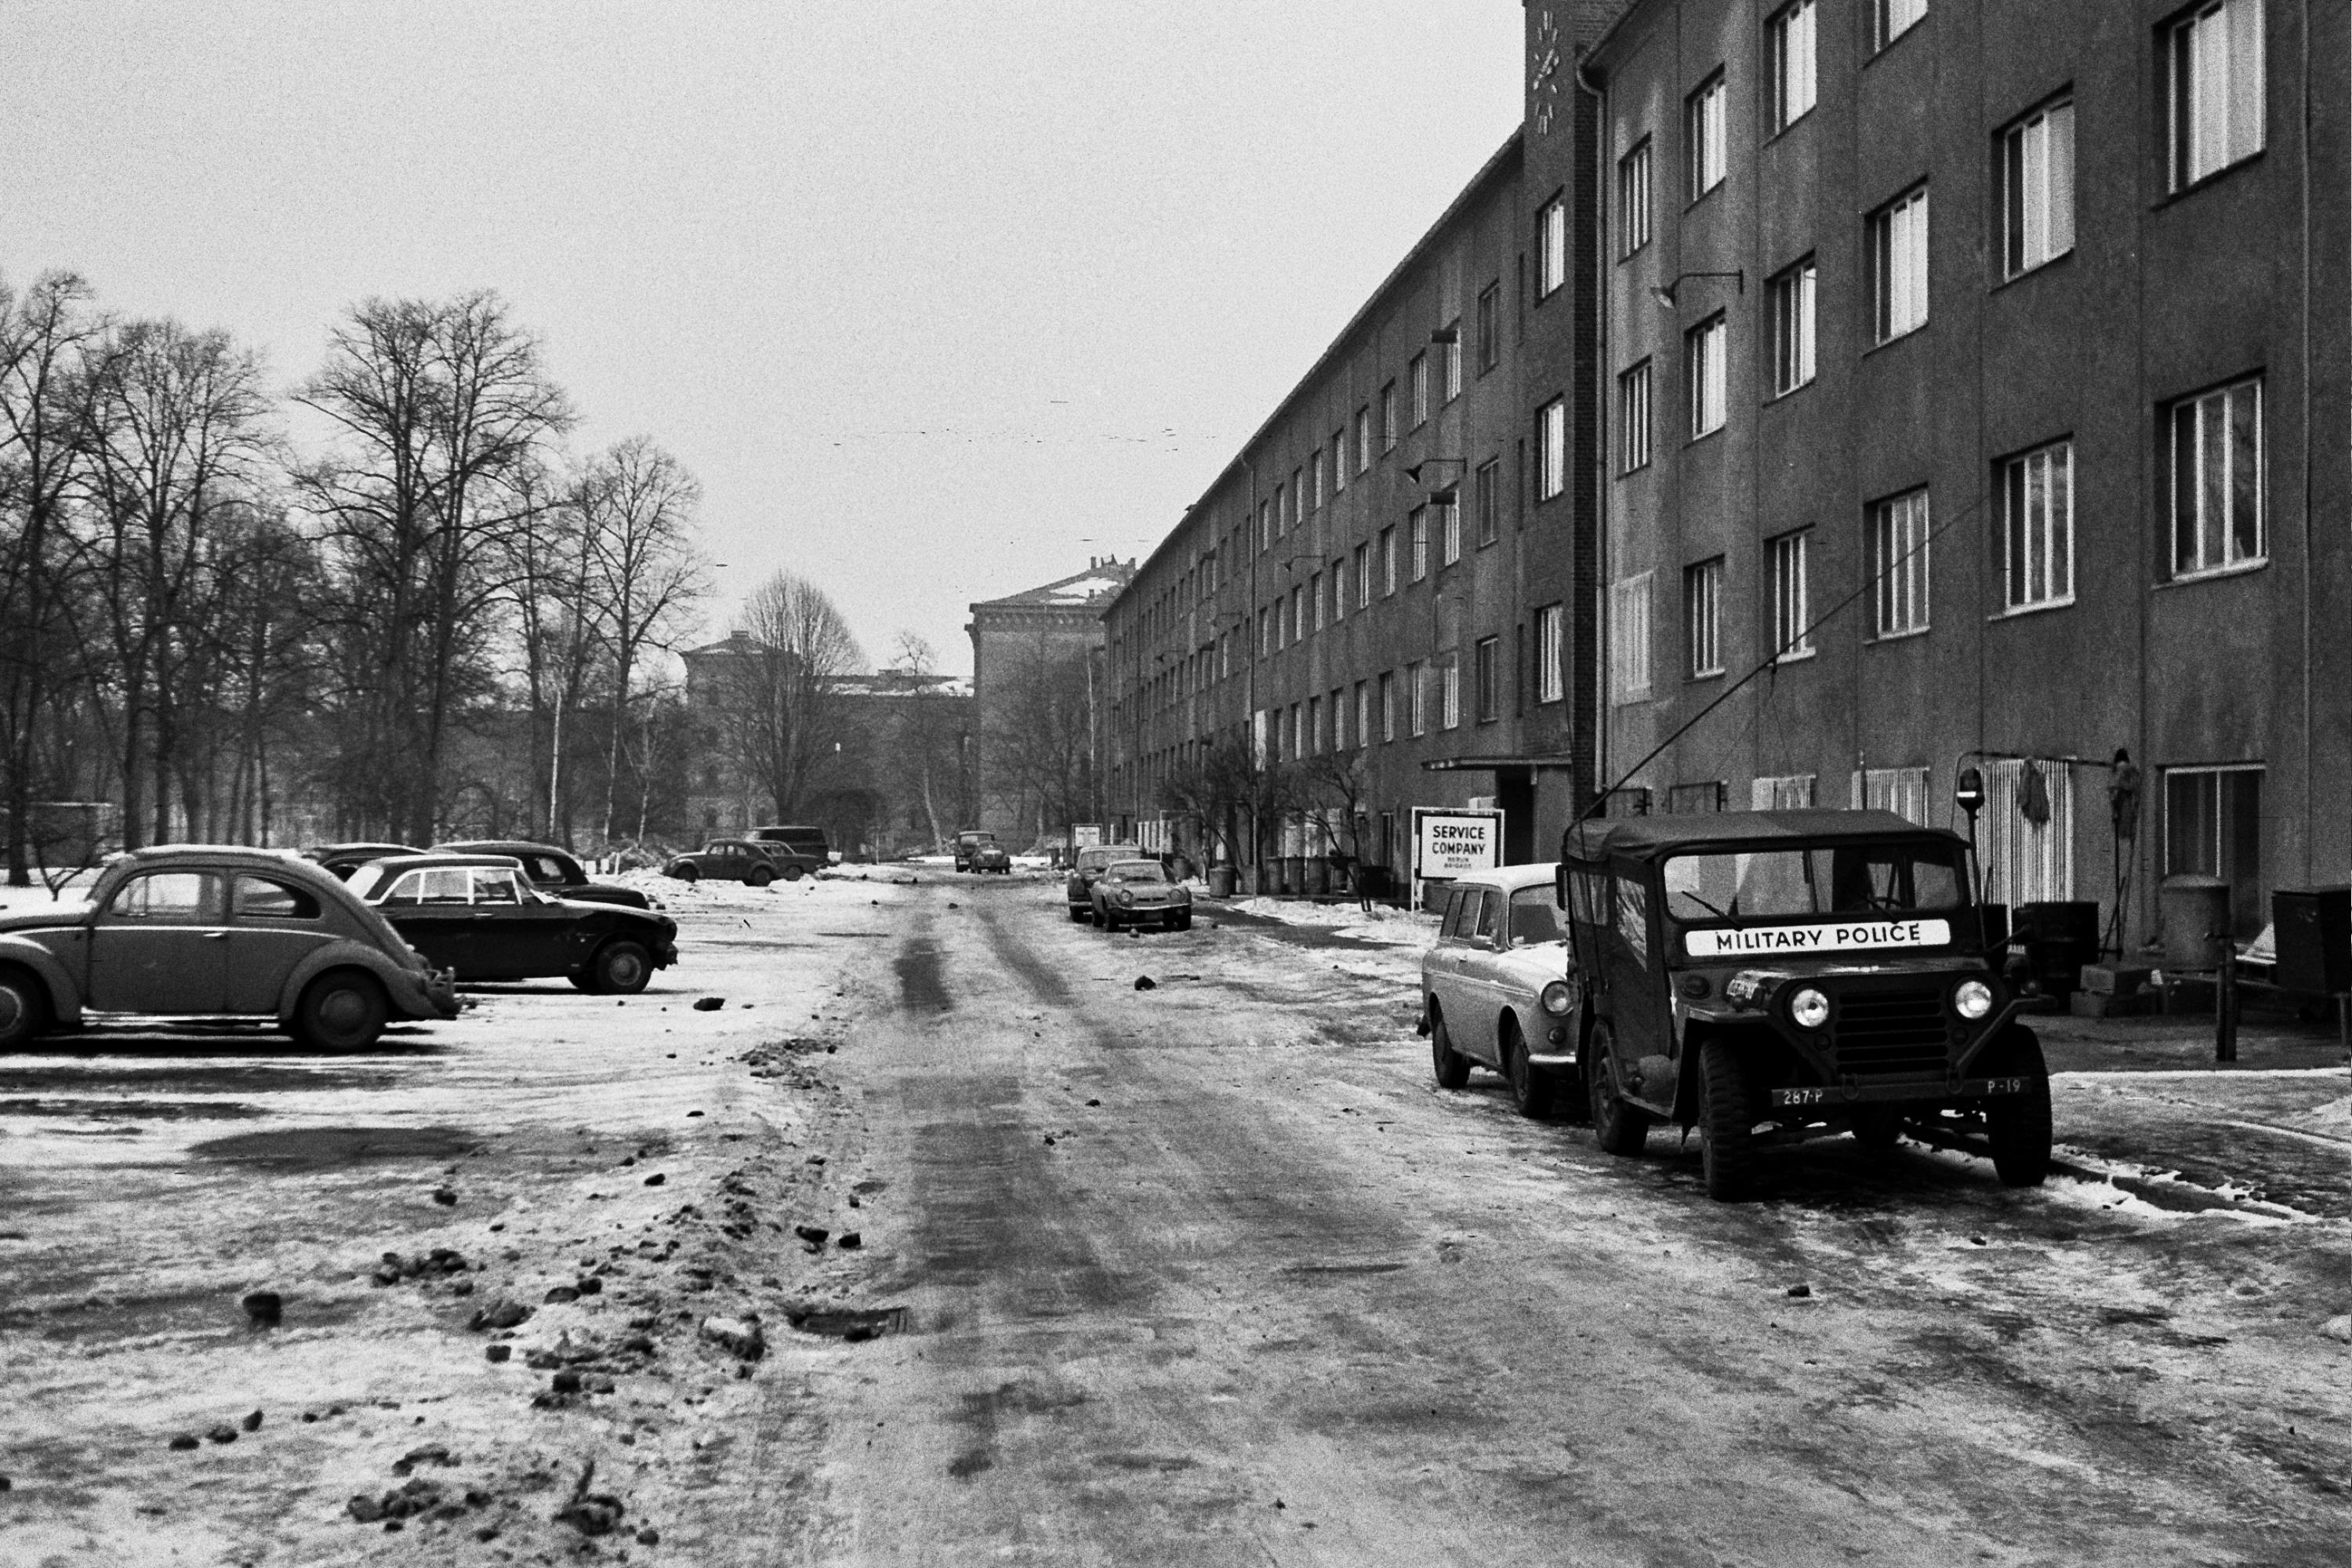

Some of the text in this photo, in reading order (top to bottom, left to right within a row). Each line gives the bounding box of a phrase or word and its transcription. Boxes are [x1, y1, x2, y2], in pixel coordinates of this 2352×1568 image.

[1432, 825, 1486, 840] SERVICE
[1432, 842, 1486, 855] COMPANY
[1716, 924, 1921, 950] MILITARY POLICE
[1987, 1080, 2020, 1094] P-19
[1784, 1089, 1823, 1104] 287-P
